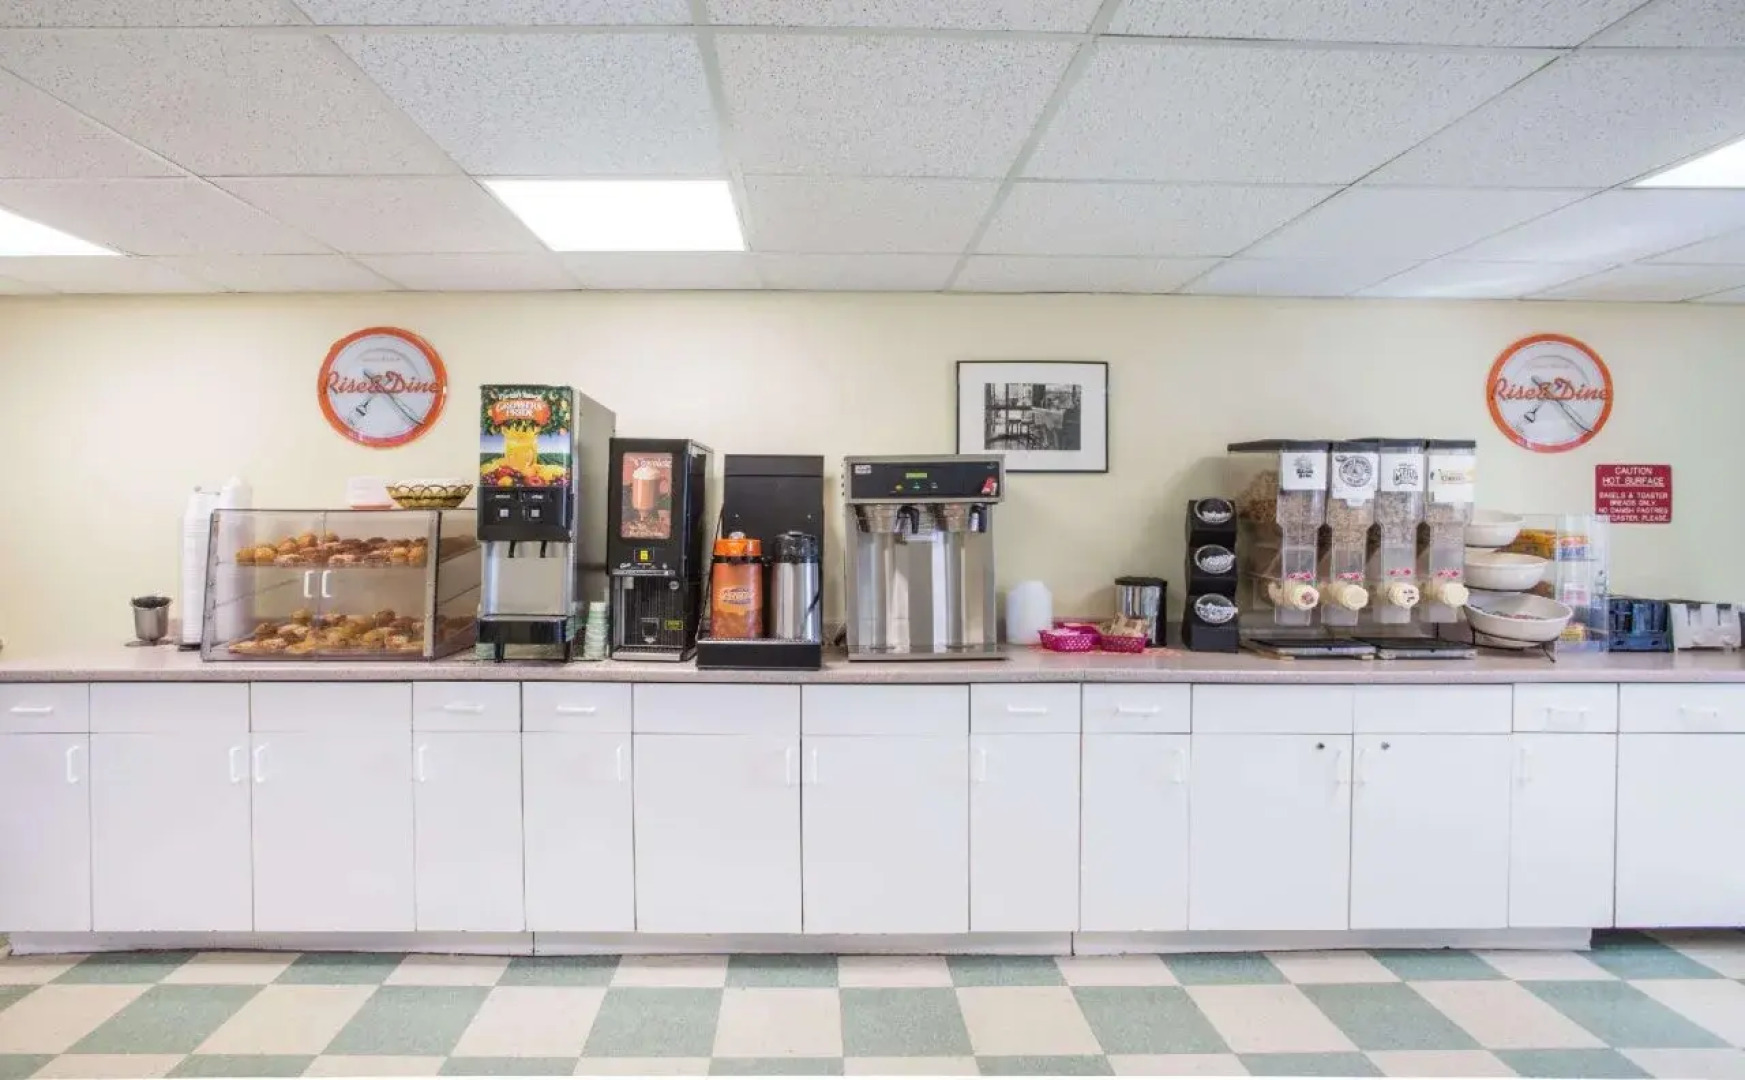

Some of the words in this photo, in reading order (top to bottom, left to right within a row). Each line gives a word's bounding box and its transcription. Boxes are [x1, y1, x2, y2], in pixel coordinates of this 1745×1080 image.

[1615, 466, 1653, 475] CAUTION
[1602, 476, 1620, 485] HOT
[1624, 476, 1664, 485] SURFACE
[1599, 491, 1626, 499] BAGELS
[1637, 491, 1668, 499] TOASTER
[1598, 506, 1608, 514] NO
[1610, 506, 1635, 514] DANISH
